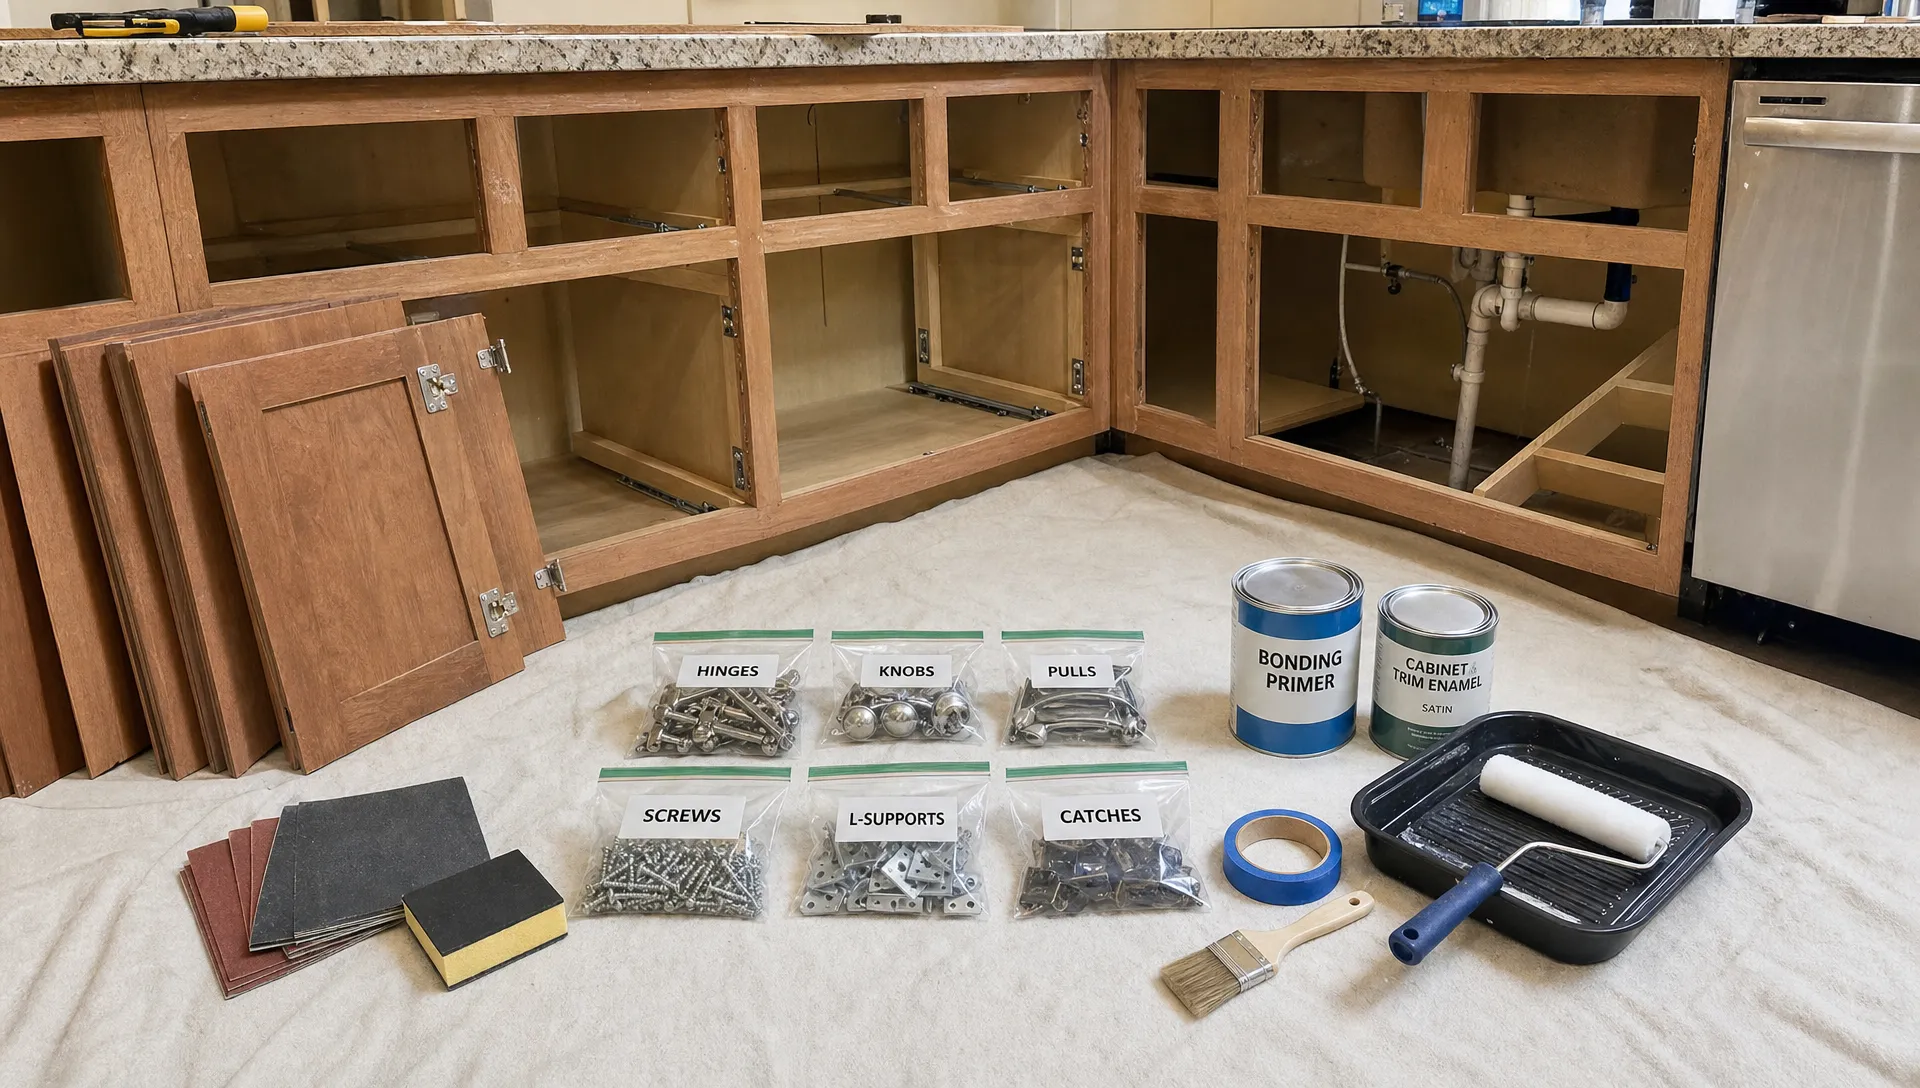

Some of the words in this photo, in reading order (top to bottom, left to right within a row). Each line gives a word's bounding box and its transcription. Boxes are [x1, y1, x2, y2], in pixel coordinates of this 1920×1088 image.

[1258, 648, 1342, 671] BONDING
[1405, 657, 1469, 676] CABINET
[697, 665, 759, 677] HINGES
[879, 665, 935, 677] KNOBS
[1048, 666, 1097, 678] PULLS
[1266, 672, 1335, 693] PRIMER
[1392, 666, 1424, 689] TRIM
[1428, 675, 1482, 692] ENAMEL
[1421, 703, 1453, 714] SATIN
[642, 808, 721, 823] SCREWS
[849, 812, 945, 826] L-SUPPORTS
[1060, 808, 1142, 824] CATCHES
